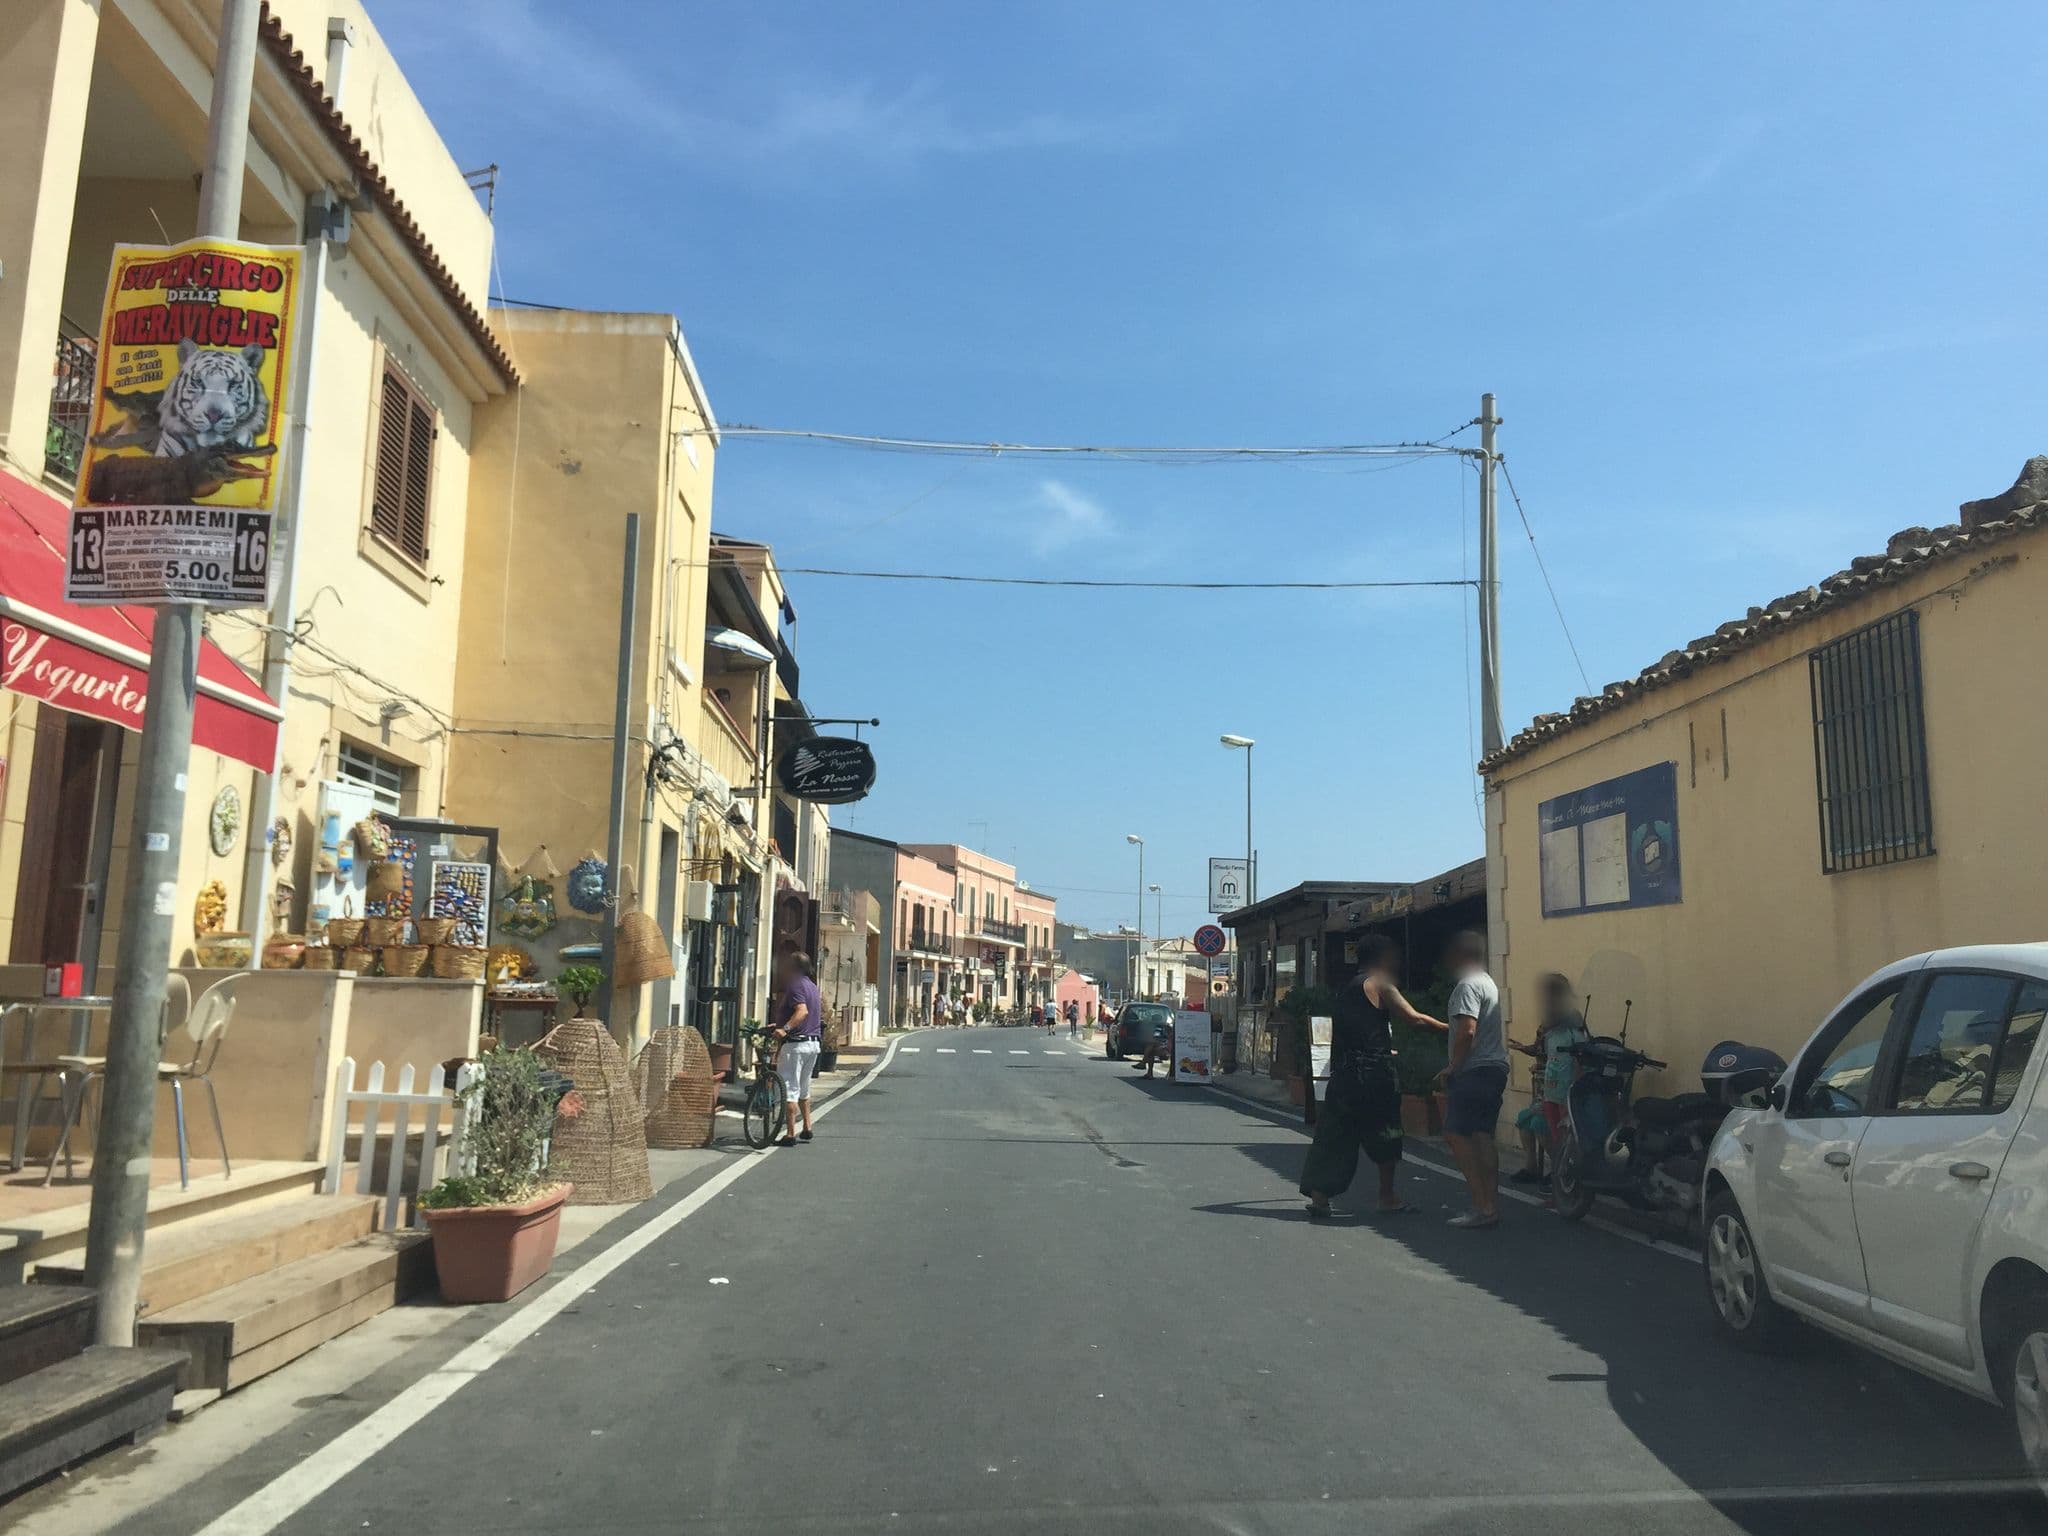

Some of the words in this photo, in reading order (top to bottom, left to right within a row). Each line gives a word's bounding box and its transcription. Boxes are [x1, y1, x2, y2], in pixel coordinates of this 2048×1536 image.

[167, 289, 219, 303] DELLE
[113, 304, 279, 348] MERAVIGLIE
[106, 509, 234, 529] MARZAMEMI
[74, 528, 102, 570] 13
[236, 530, 267, 573] 16
[165, 560, 220, 581] 5.00
[797, 775, 817, 787] La
[822, 774, 860, 784] Nassa
